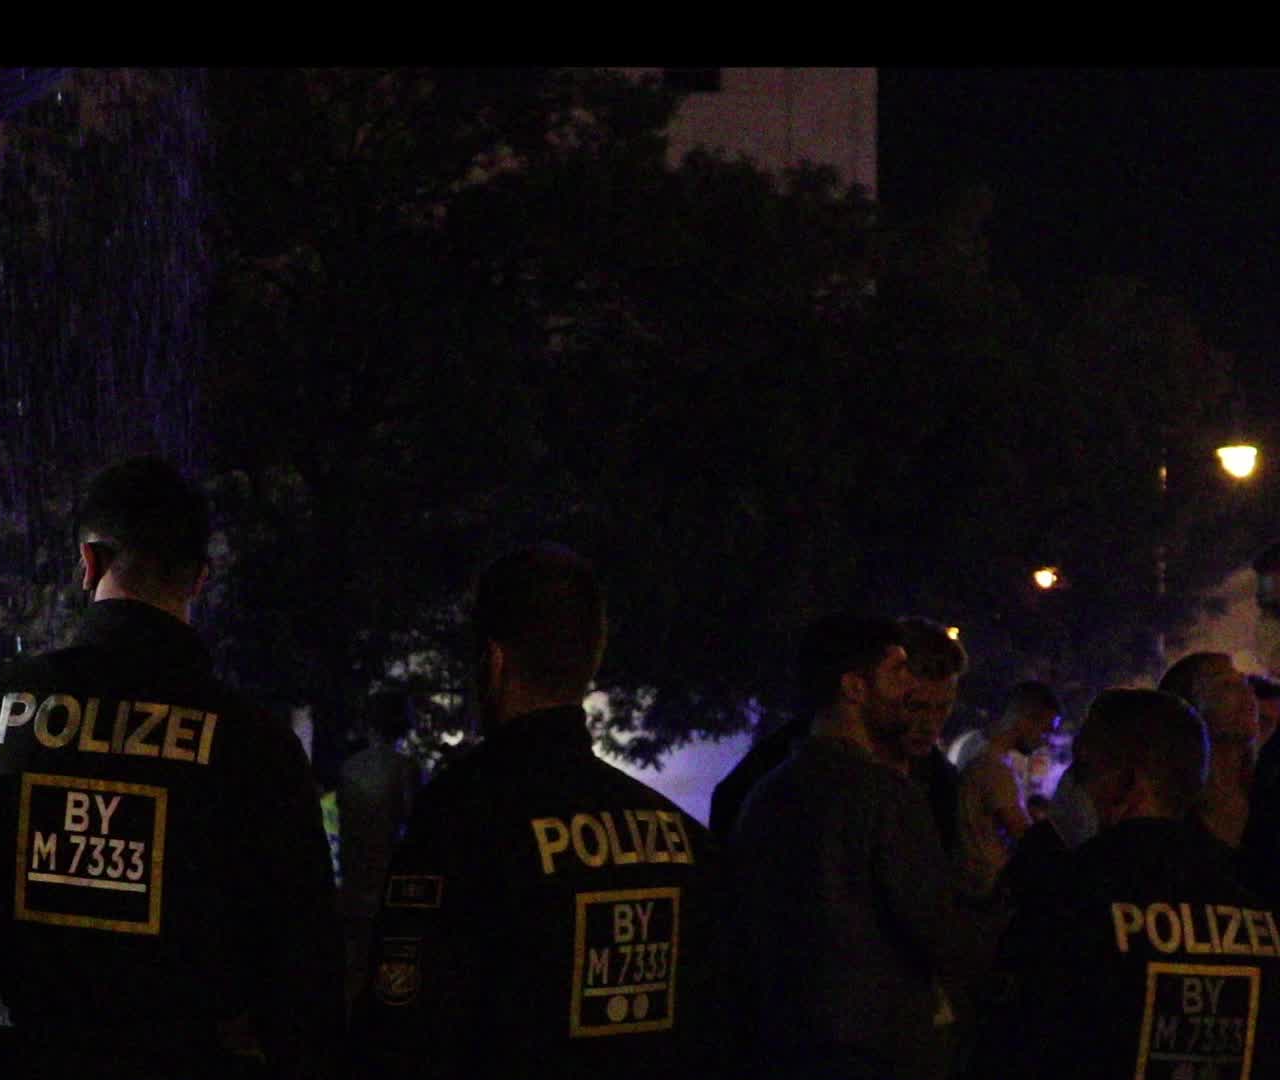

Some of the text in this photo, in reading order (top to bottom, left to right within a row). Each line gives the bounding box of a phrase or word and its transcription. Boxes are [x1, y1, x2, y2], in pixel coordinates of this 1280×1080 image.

[64, 791, 122, 835] BY
[31, 831, 146, 881] M 7333
[530, 809, 695, 875] POLIZEI
[612, 901, 654, 944] BY
[587, 945, 609, 986] M
[1183, 976, 1224, 1014] BY
[1154, 1015, 1178, 1050] M
